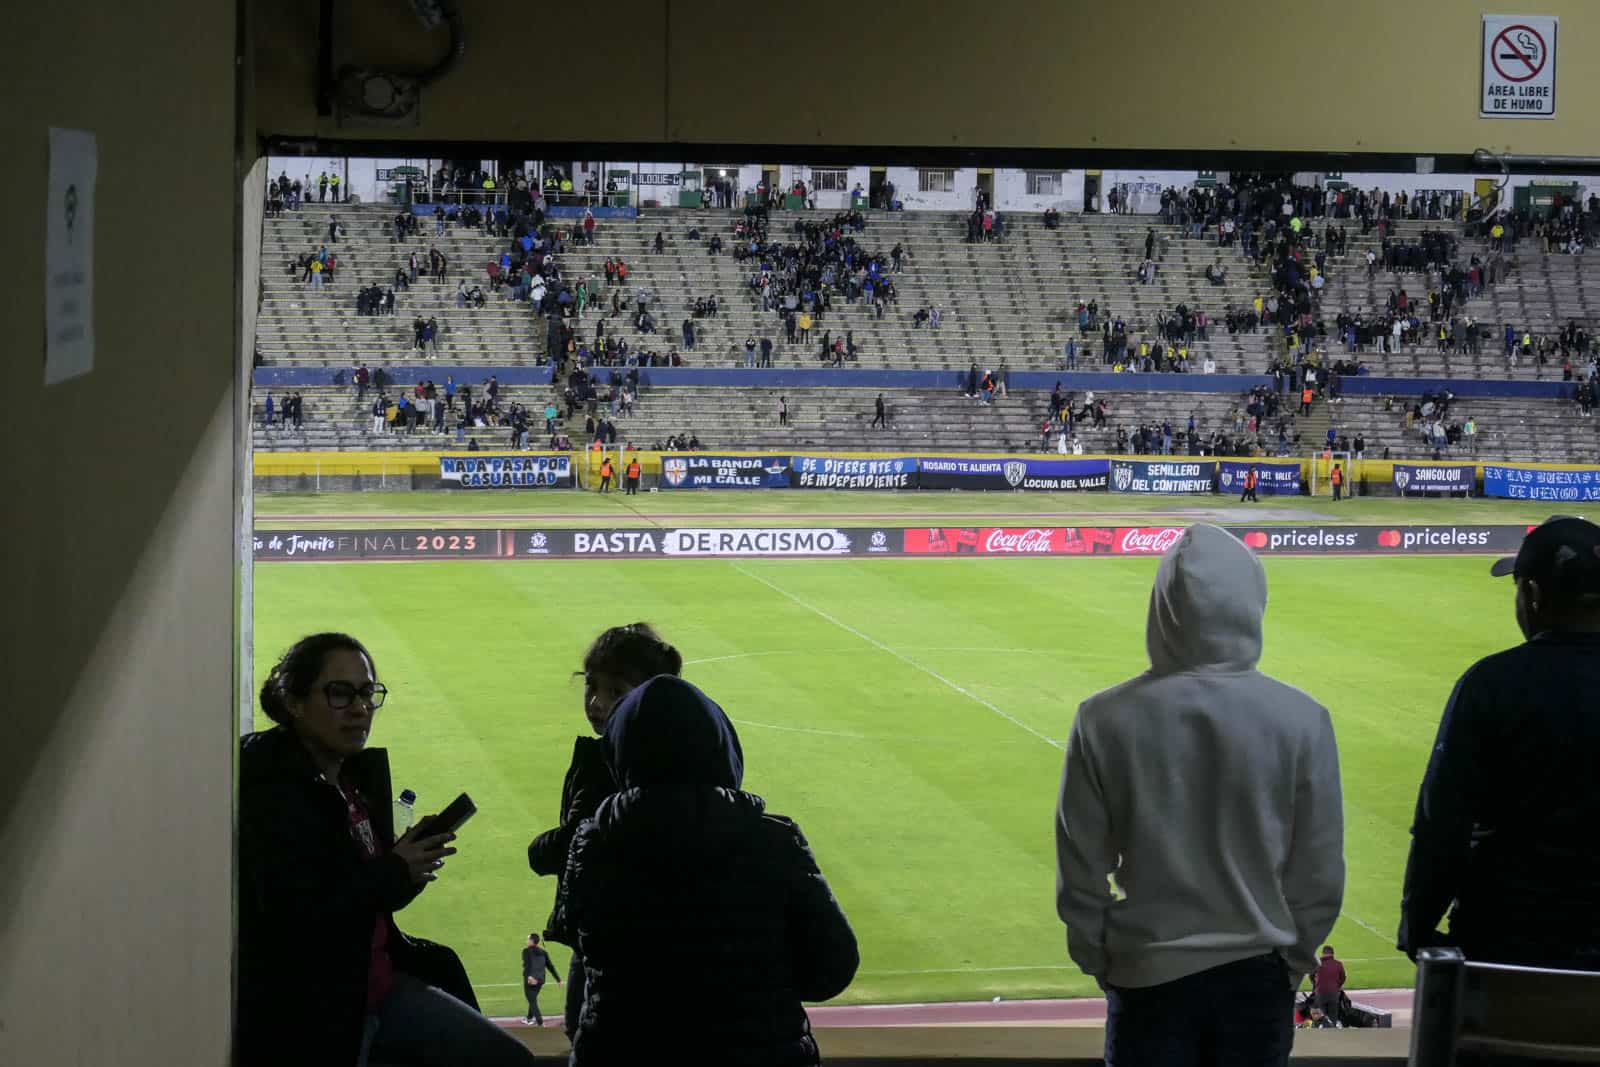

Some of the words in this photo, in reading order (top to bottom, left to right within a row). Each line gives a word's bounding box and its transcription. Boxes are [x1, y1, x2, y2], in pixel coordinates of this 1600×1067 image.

[1519, 86, 1549, 97] LIBRE
[1494, 99, 1507, 109] DE
[1511, 99, 1543, 110] HUMO
[442, 457, 487, 472] NADA
[491, 457, 533, 472] PASA
[538, 456, 569, 471] POR
[689, 459, 709, 468] LA
[711, 459, 762, 469] BANDA
[824, 459, 891, 474] DIFERENTE
[923, 461, 957, 471] ROSARIO
[957, 462, 968, 472] TE
[969, 463, 1002, 473] ALIENTA
[1147, 464, 1200, 476] SEMILLERO
[460, 471, 558, 487] CASUALIDAD
[718, 468, 737, 477] DE
[1261, 470, 1272, 480] DEL
[1415, 468, 1461, 482] SANGOLQUI
[694, 476, 712, 485] MI
[716, 476, 761, 486] CALLE
[815, 473, 908, 489] INDEPENDIENTE
[1023, 478, 1058, 489] LOCURA
[1060, 478, 1077, 489] DEL
[1079, 476, 1106, 489] VALLE
[1132, 479, 1151, 491] DEL
[1152, 479, 1212, 491] CONTINENTE
[574, 533, 657, 553] BASTA
[679, 533, 711, 551] DE
[719, 532, 835, 551] RACISMO
[986, 528, 1055, 552] Coca-Cola
[1270, 530, 1356, 549] priceless
[1404, 528, 1489, 548] priceless
[268, 535, 283, 551] de
[286, 534, 335, 556] Janeiro
[337, 537, 411, 551] FINAL
[415, 536, 476, 550] 2023
